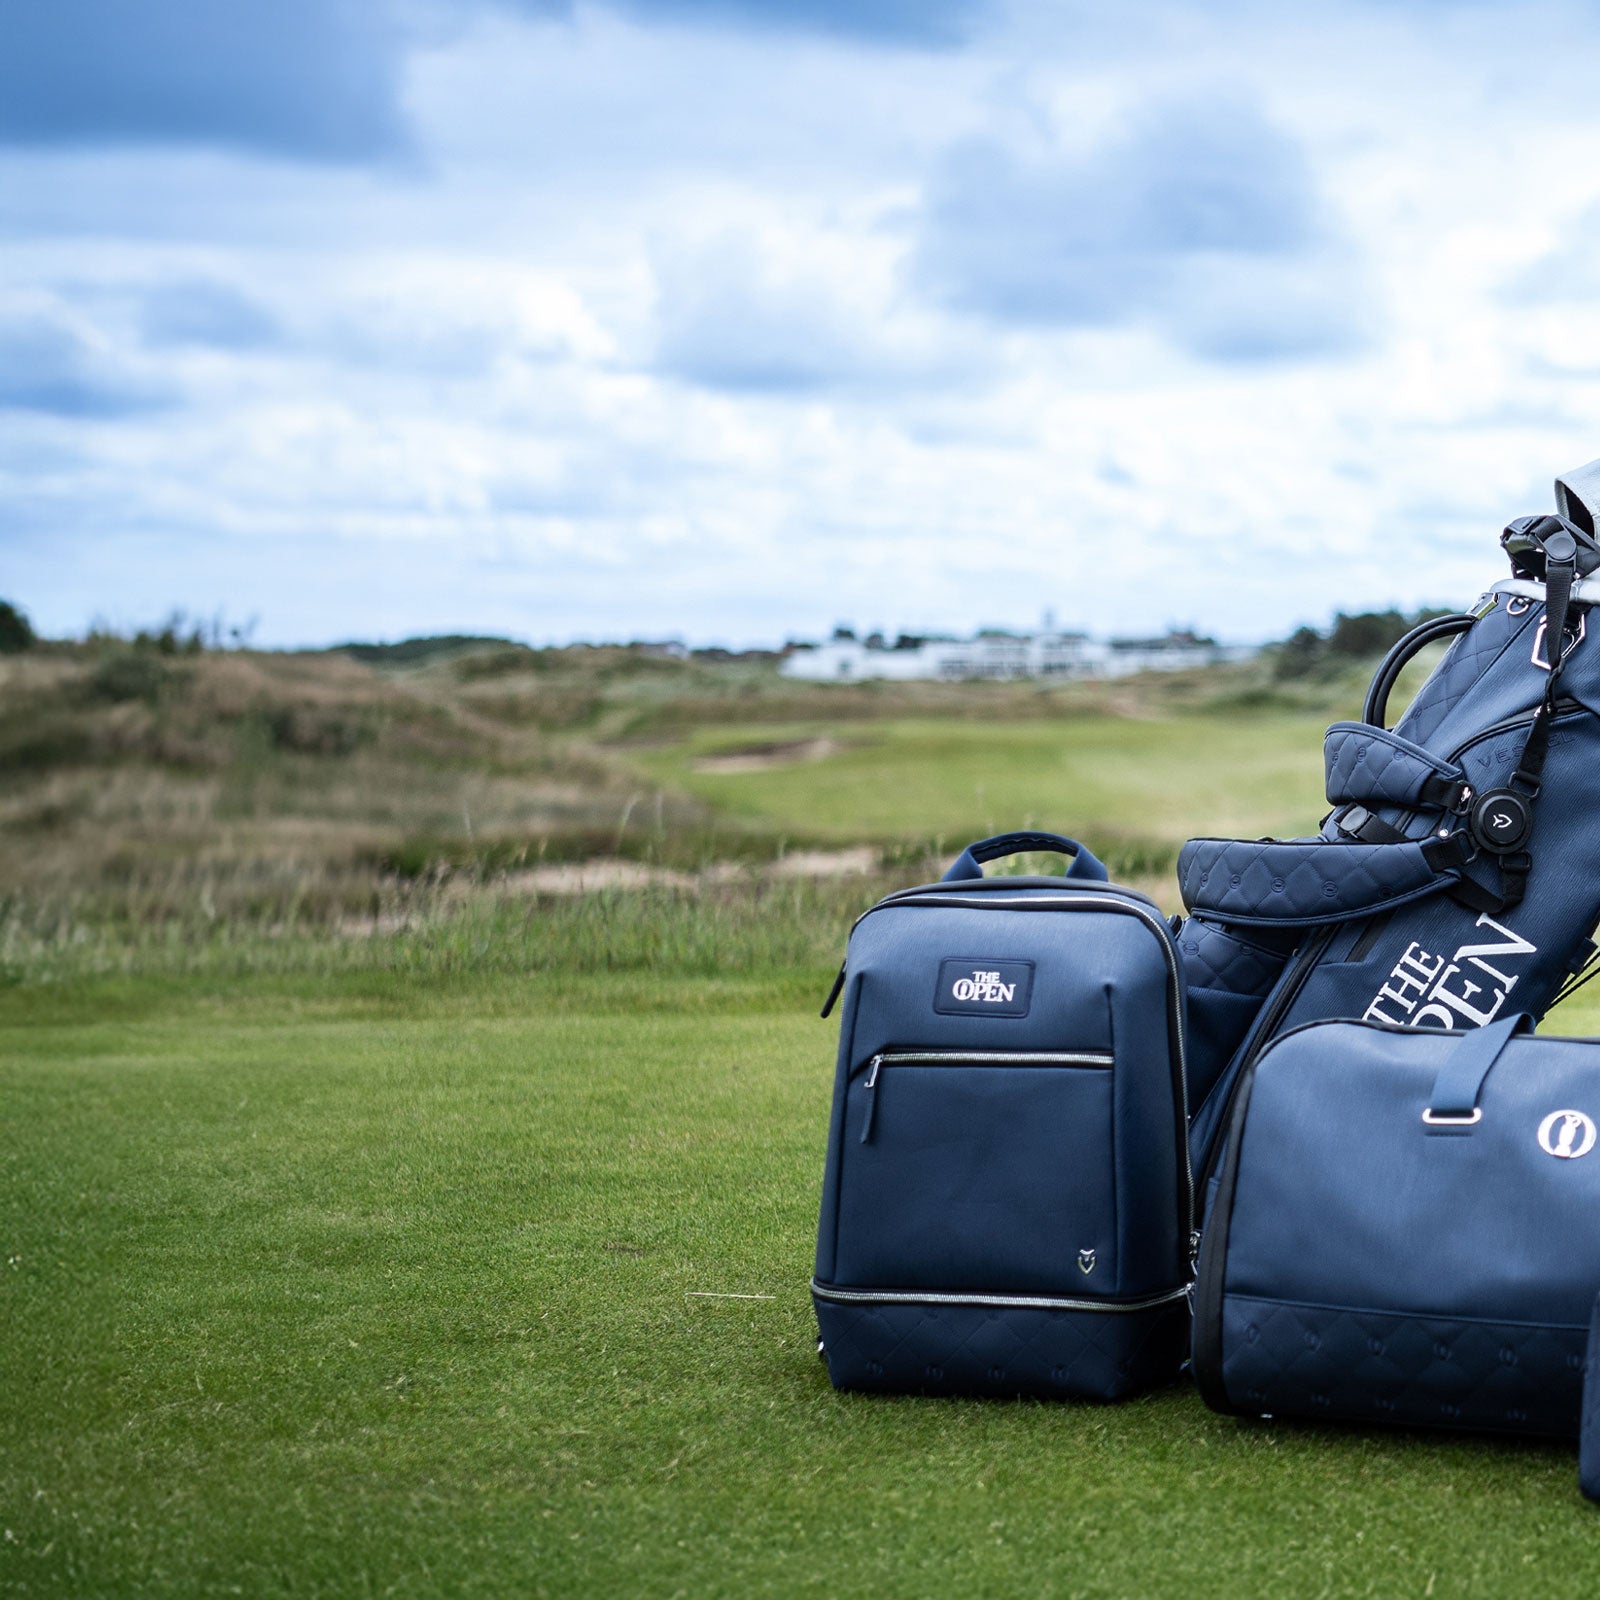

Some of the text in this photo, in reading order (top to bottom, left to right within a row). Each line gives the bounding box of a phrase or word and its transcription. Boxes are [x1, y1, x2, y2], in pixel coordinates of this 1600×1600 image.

[1477, 731, 1576, 768] VESEL
[952, 978, 1017, 1002] OPEN
[971, 971, 1001, 984] THE
[1361, 941, 1445, 1026] THE
